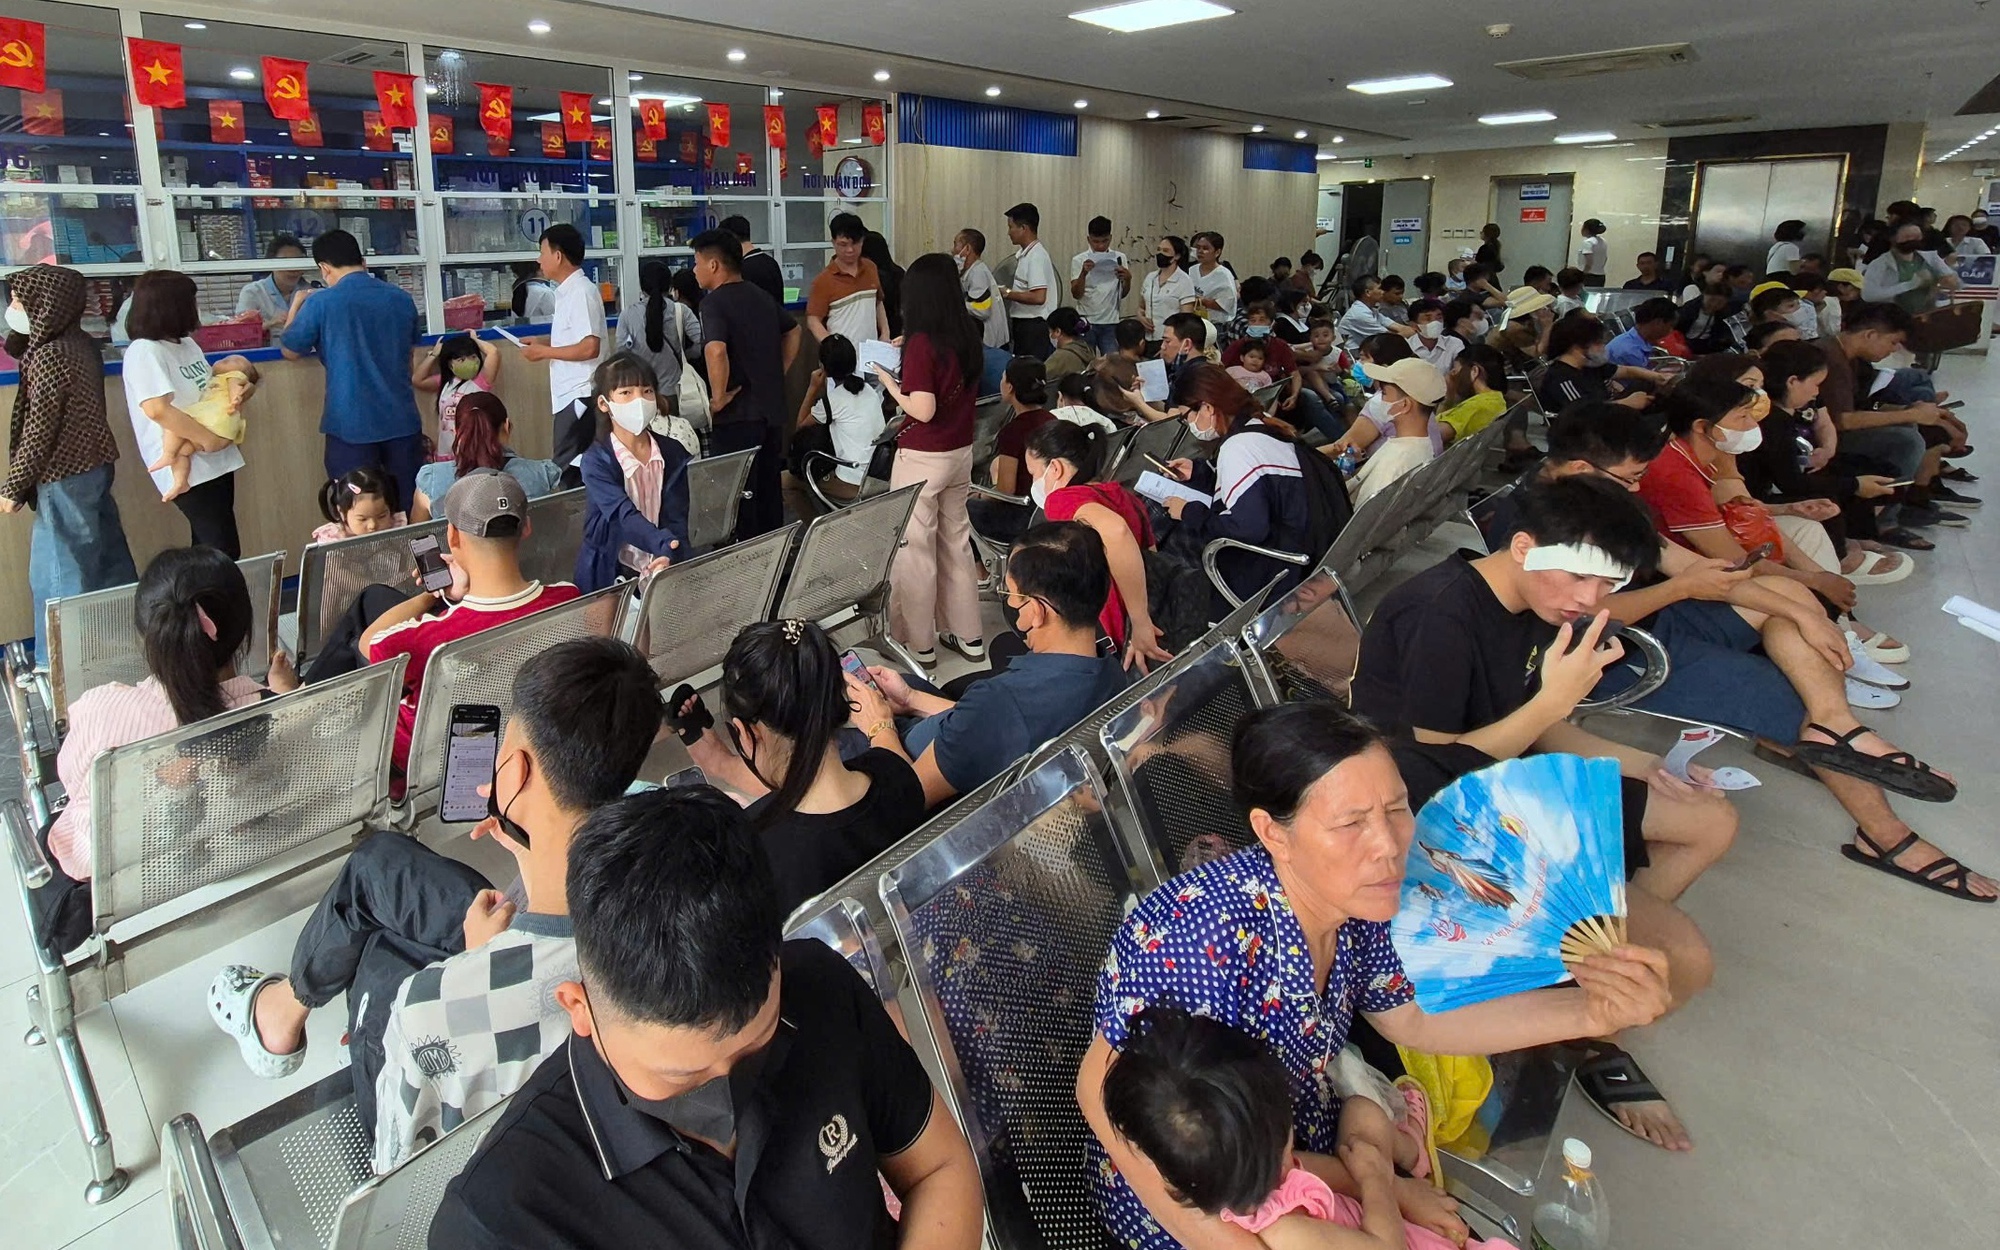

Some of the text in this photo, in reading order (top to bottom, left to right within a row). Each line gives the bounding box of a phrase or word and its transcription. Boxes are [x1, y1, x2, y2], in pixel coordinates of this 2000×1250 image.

[528, 217, 545, 234] 11
[496, 496, 509, 510] B
[419, 1049, 448, 1071] PUMA
[824, 1122, 841, 1146] R
